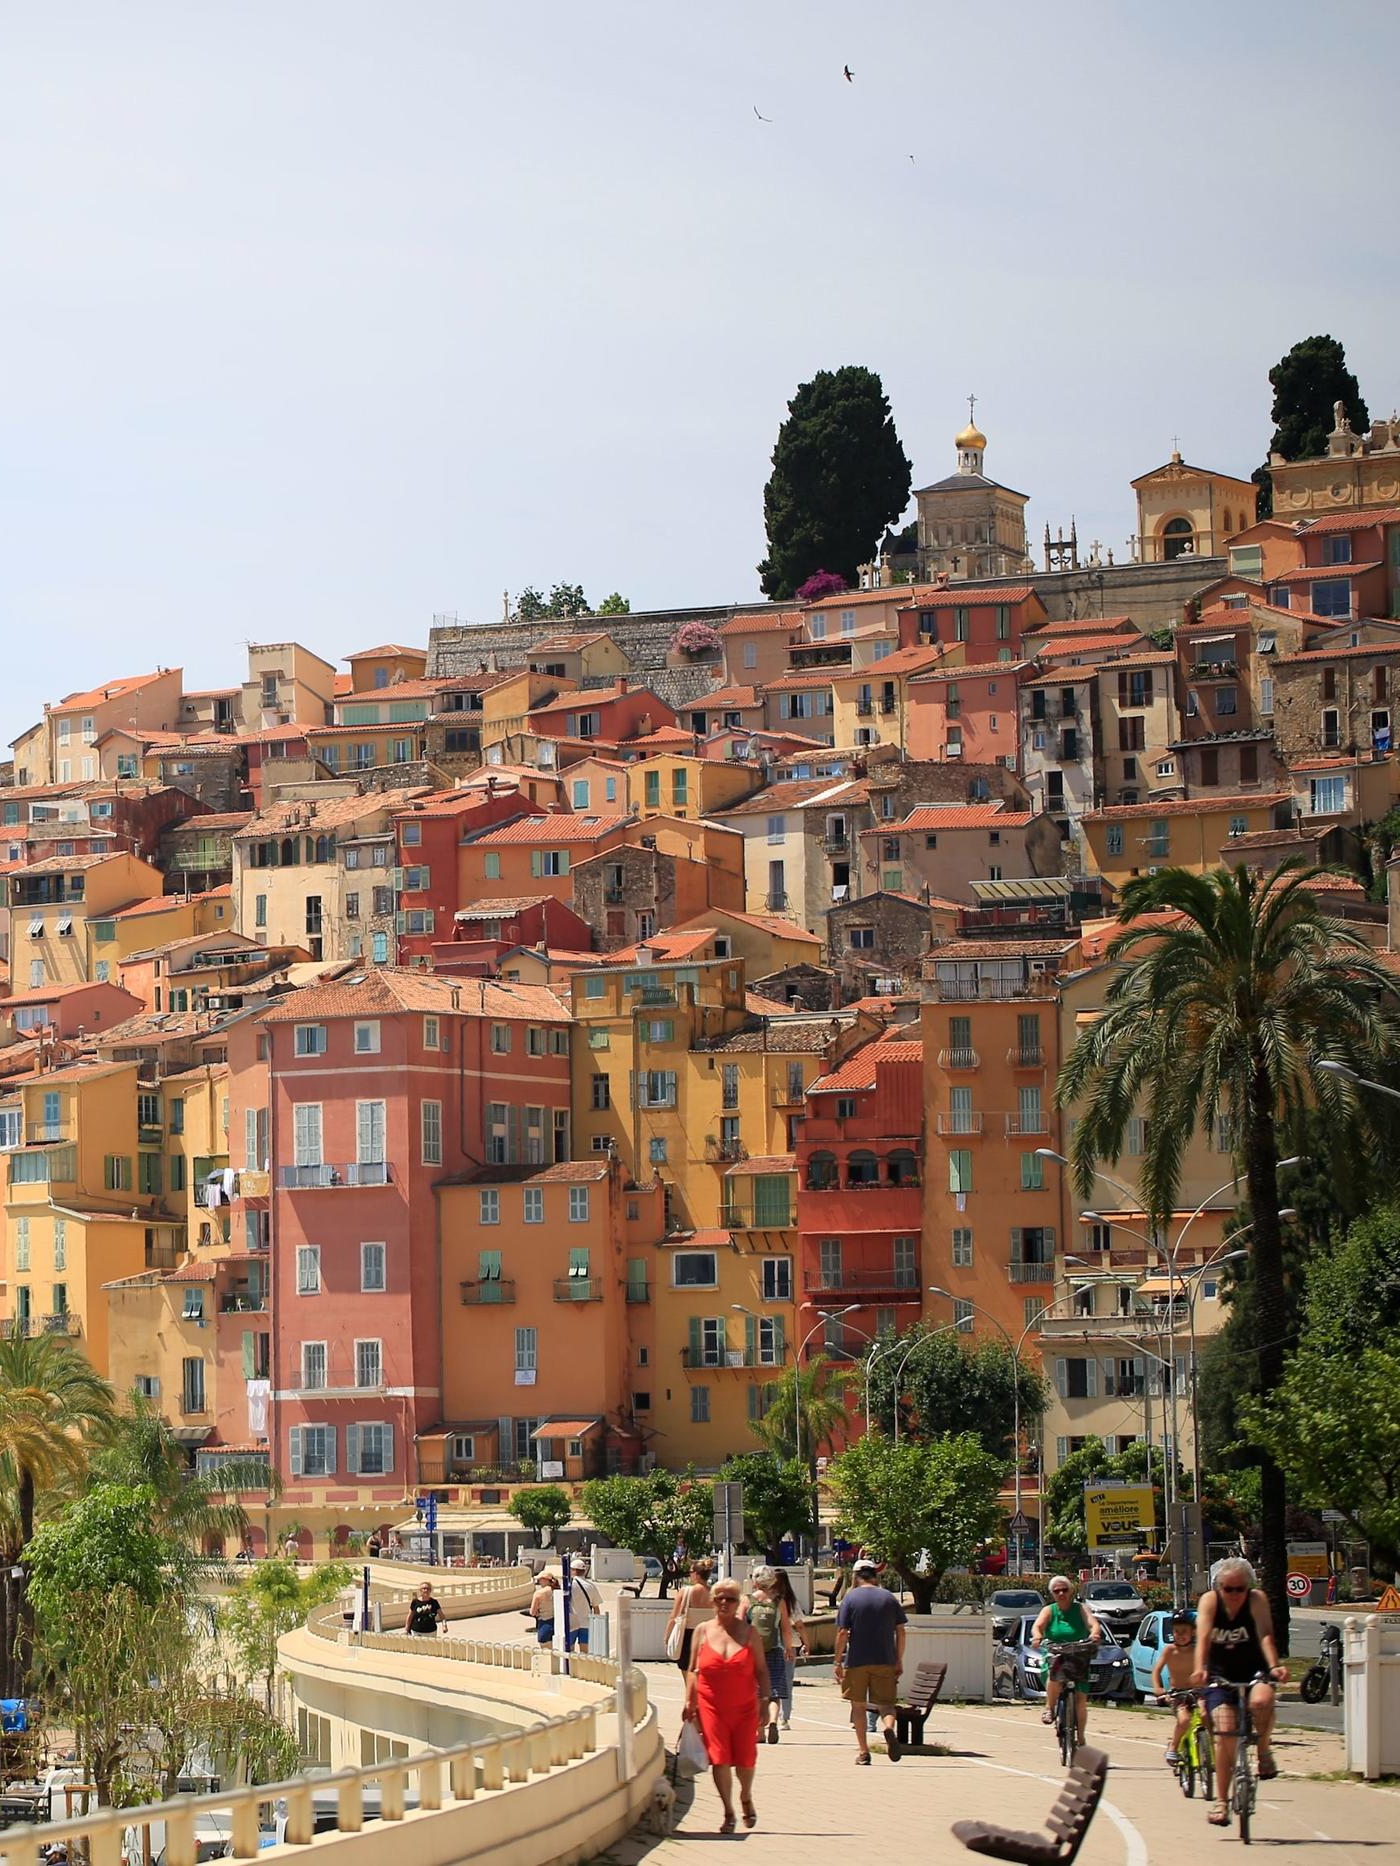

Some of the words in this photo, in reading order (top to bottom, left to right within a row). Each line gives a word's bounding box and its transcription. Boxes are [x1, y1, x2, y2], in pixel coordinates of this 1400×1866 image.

[1099, 1505, 1139, 1514] améliore
[1101, 1520, 1141, 1532] VOUS
[1289, 1579, 1306, 1591] 30
[1211, 1627, 1249, 1642] NASA
